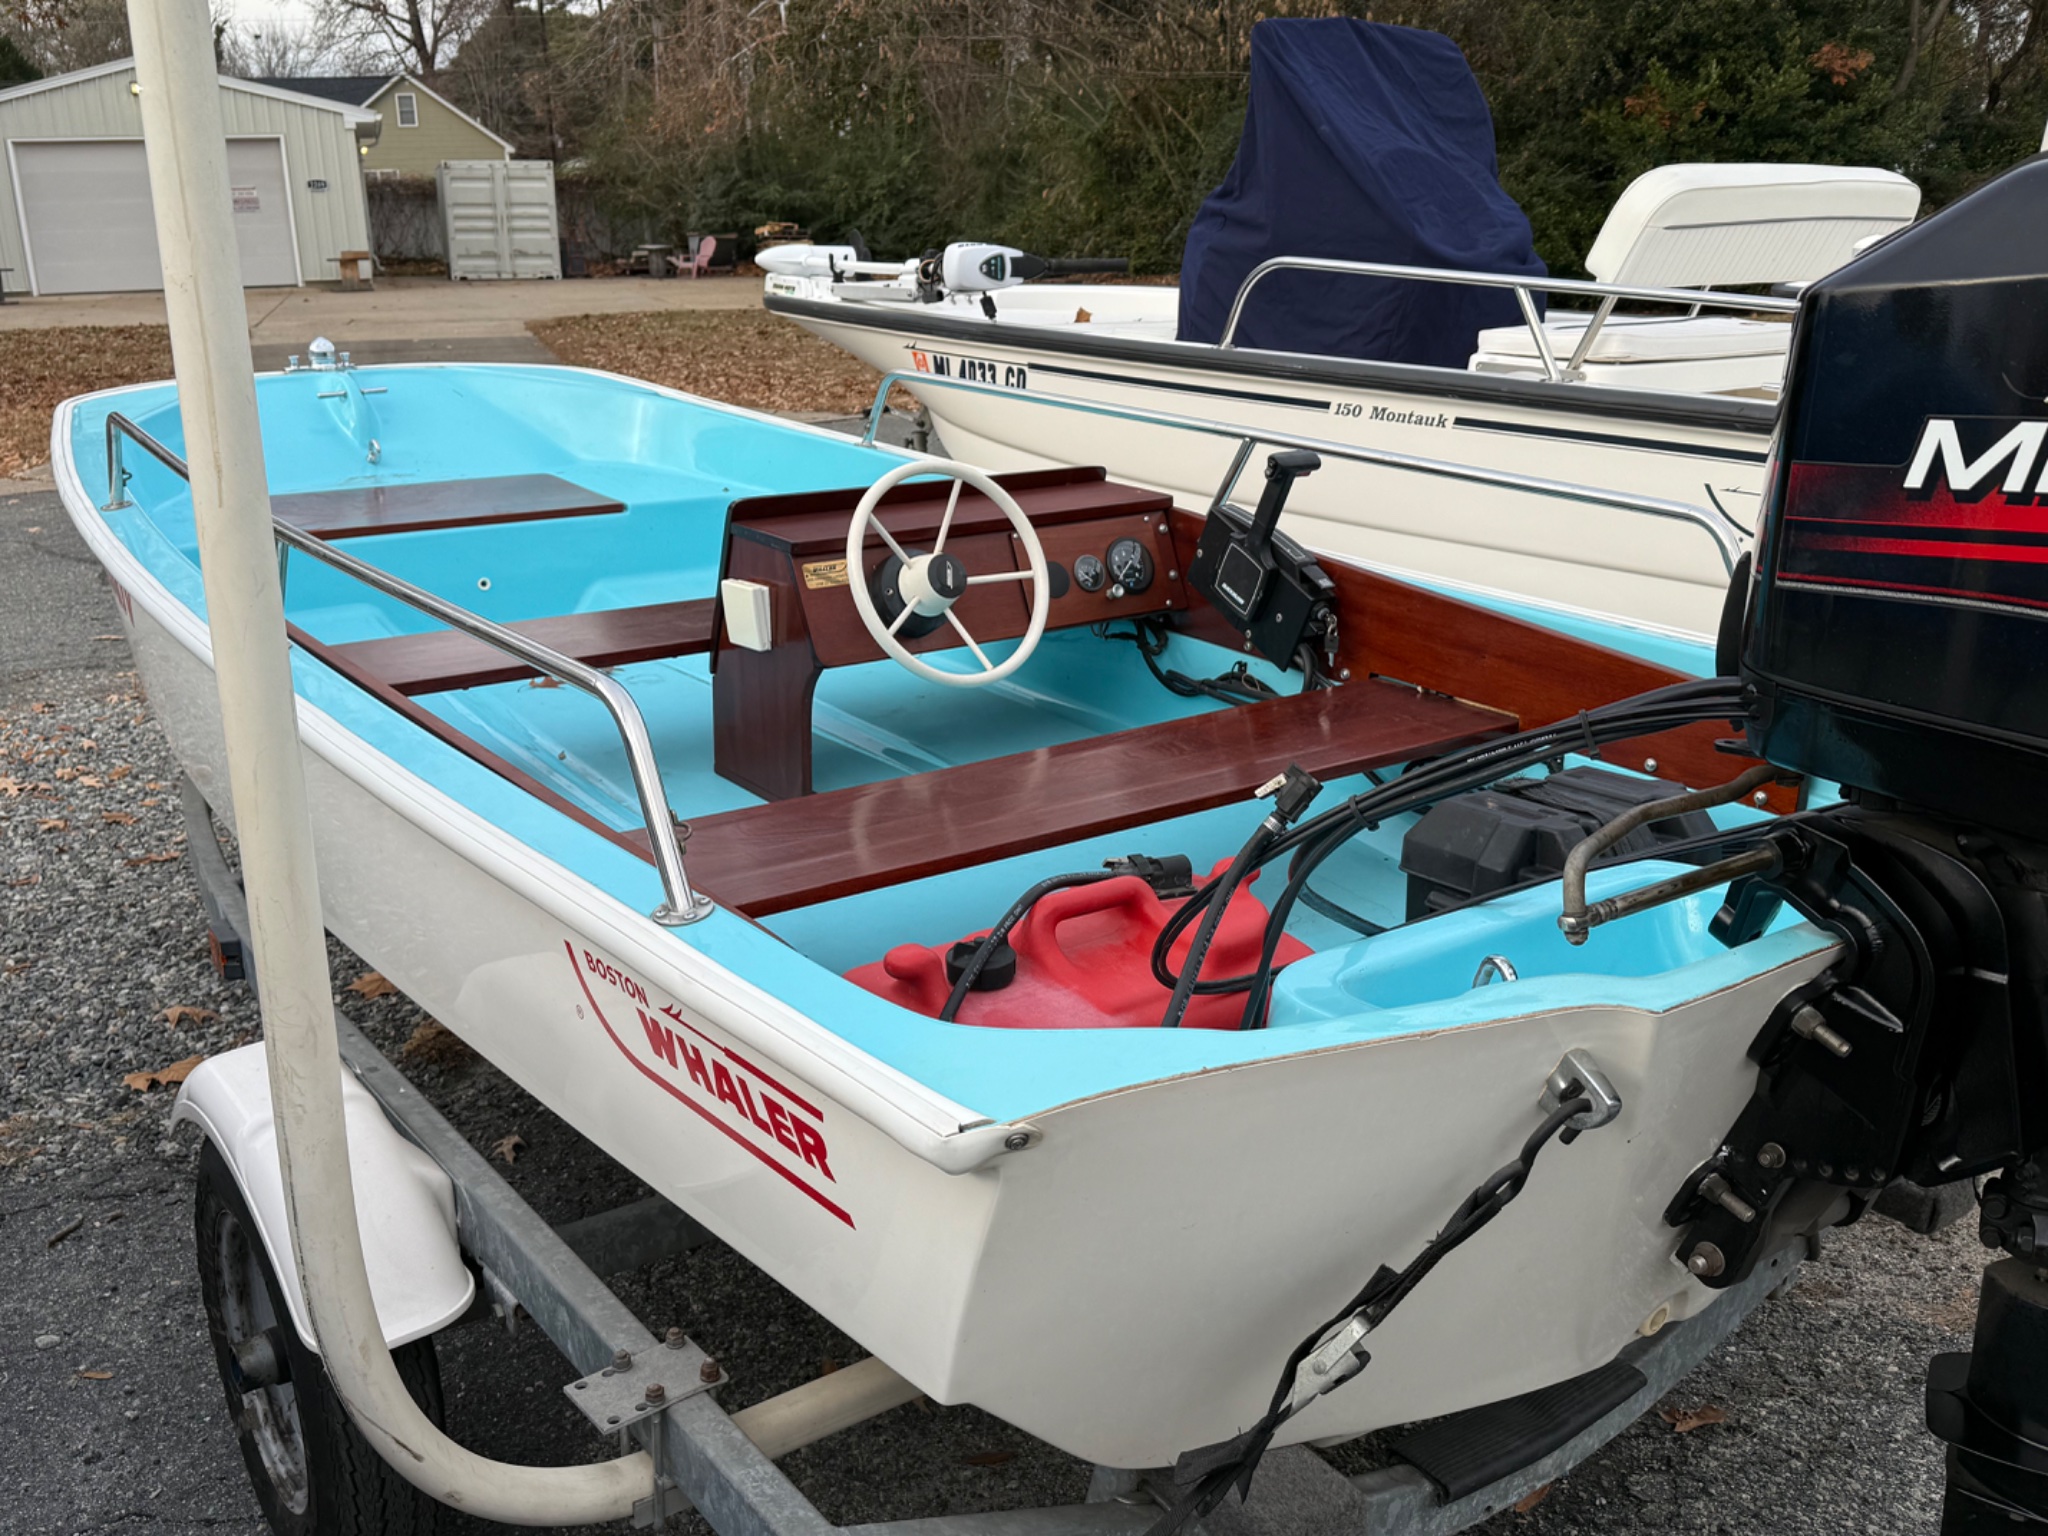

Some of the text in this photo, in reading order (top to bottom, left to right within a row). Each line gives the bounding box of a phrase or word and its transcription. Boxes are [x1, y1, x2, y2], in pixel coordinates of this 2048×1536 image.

[1334, 402, 1449, 428] 150 Montauk
[1903, 419, 2048, 494] M
[584, 949, 650, 1009] BOSTON
[636, 1007, 836, 1183] WHALER
